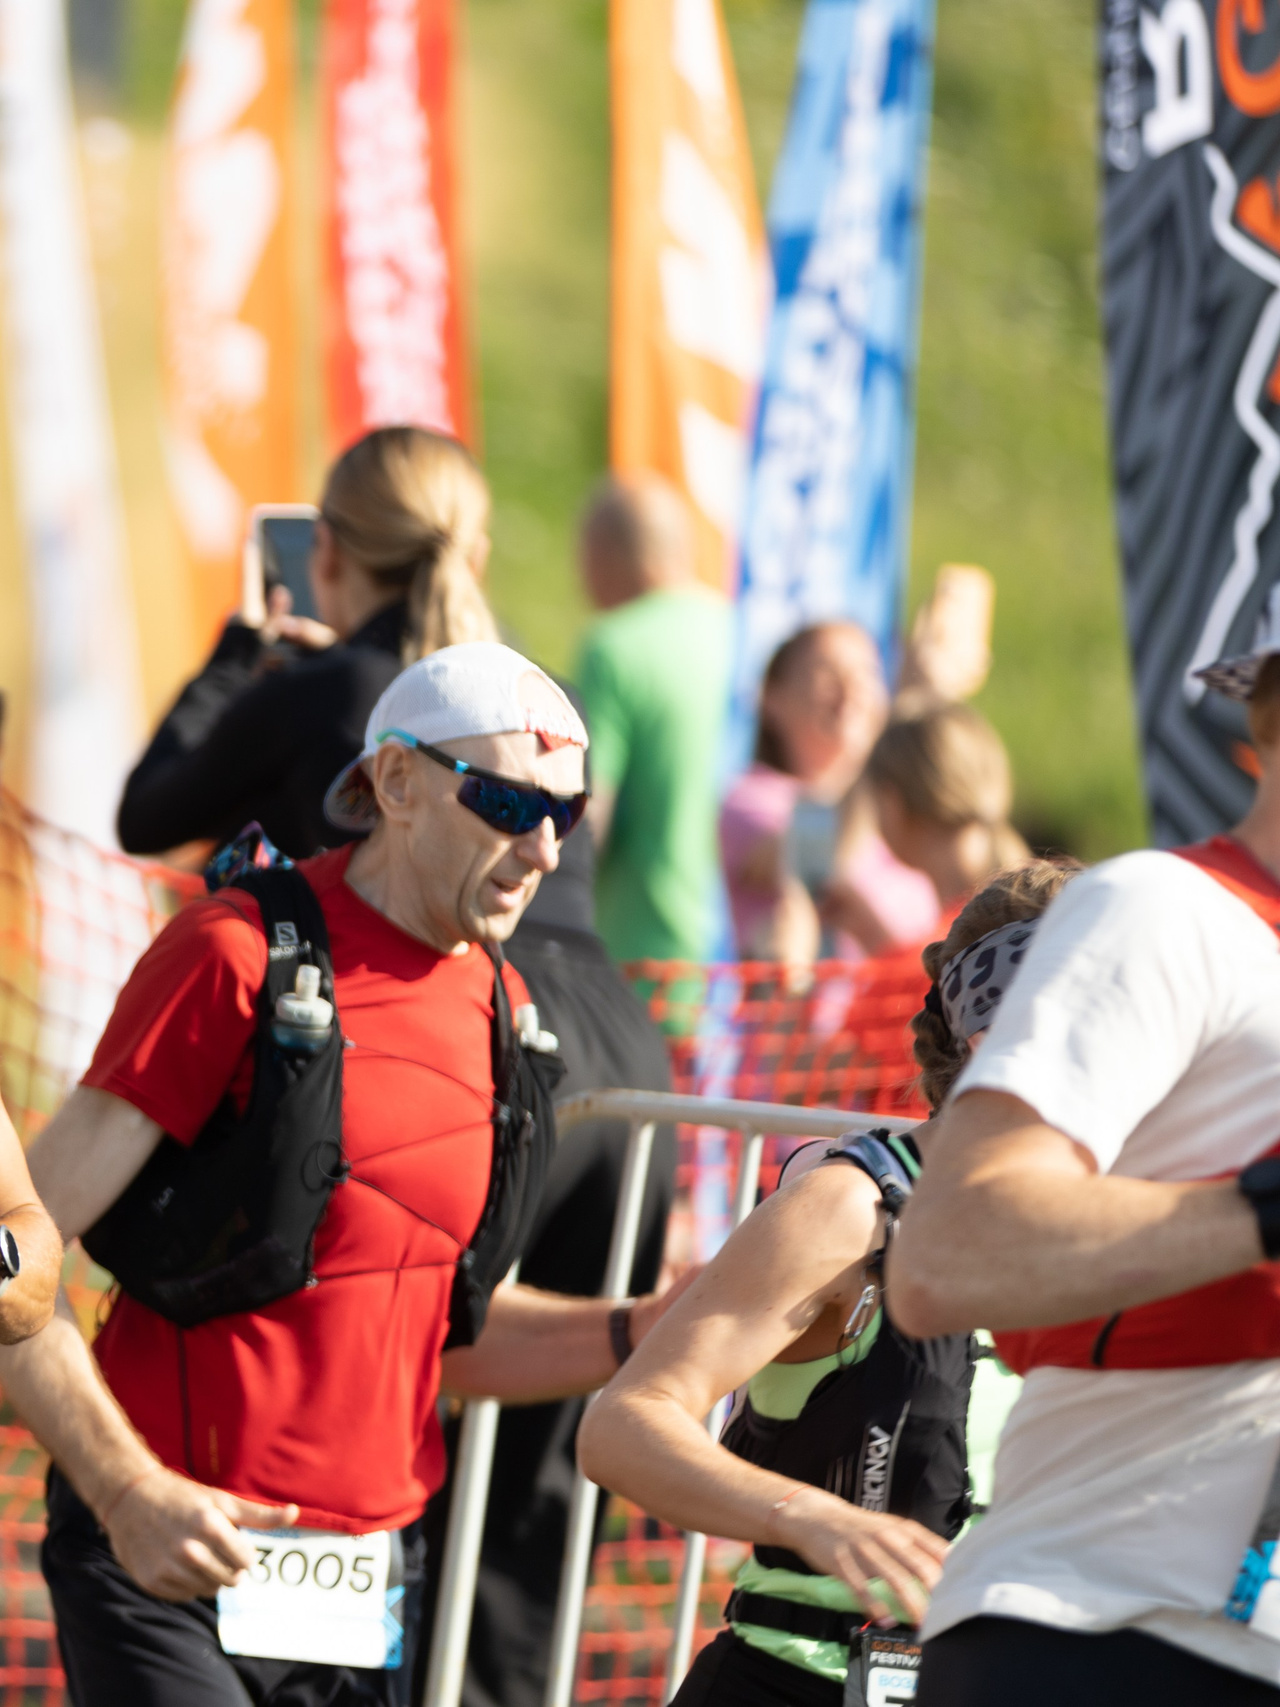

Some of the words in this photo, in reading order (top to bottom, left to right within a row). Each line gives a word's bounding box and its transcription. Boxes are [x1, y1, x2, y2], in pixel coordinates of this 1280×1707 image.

[248, 1546, 375, 1593] 3005
[871, 1640, 892, 1652] GO
[878, 1675, 919, 1691] ВОЗ
